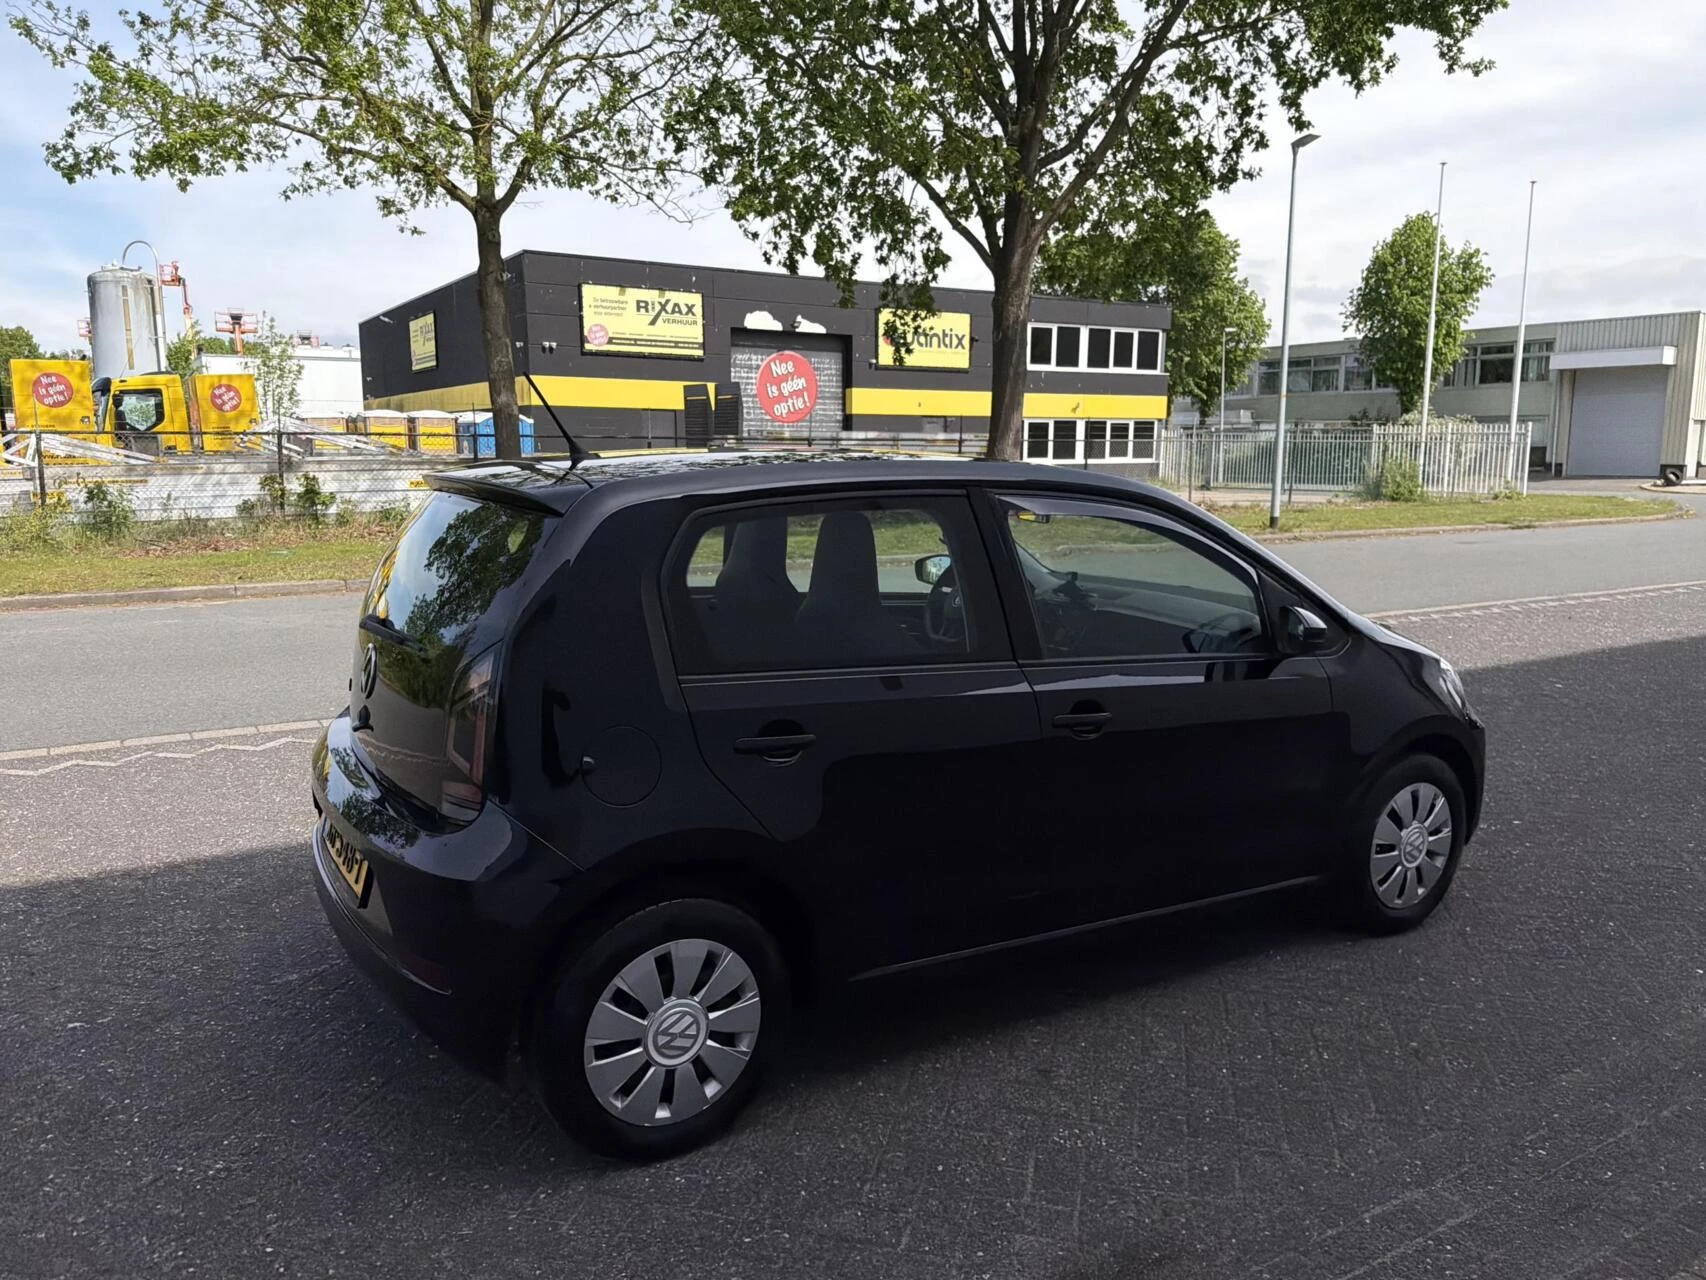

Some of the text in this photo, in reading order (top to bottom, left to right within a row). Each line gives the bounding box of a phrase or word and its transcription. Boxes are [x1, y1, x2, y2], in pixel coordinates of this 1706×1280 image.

[662, 318, 698, 326] VERHUUR
[770, 360, 795, 377] Nee
[766, 375, 807, 398] is géén
[773, 392, 810, 418] optie!
